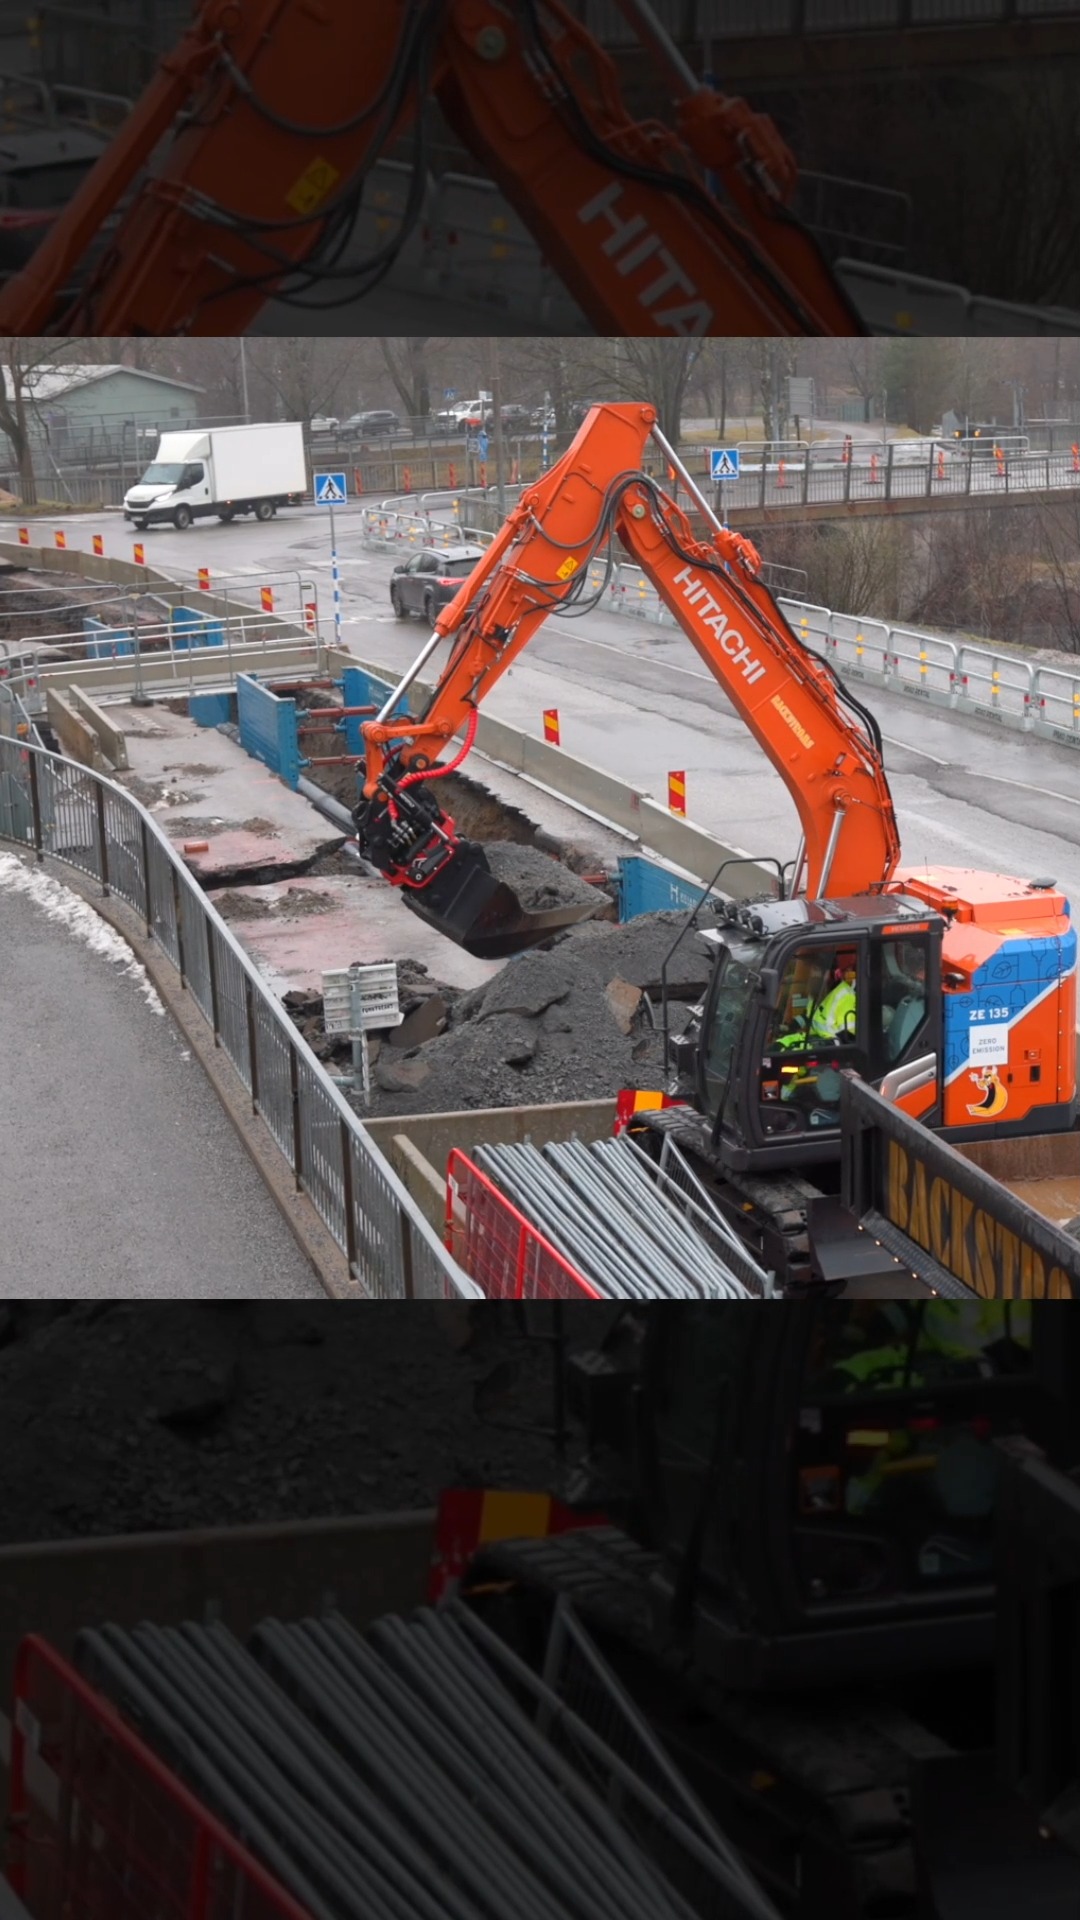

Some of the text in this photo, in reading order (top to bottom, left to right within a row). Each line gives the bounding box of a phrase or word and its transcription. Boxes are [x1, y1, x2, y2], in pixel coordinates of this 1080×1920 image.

[673, 566, 767, 685] HITACHI
[969, 1007, 1009, 1021] ZE 135
[972, 1046, 1005, 1054] EMISSION
